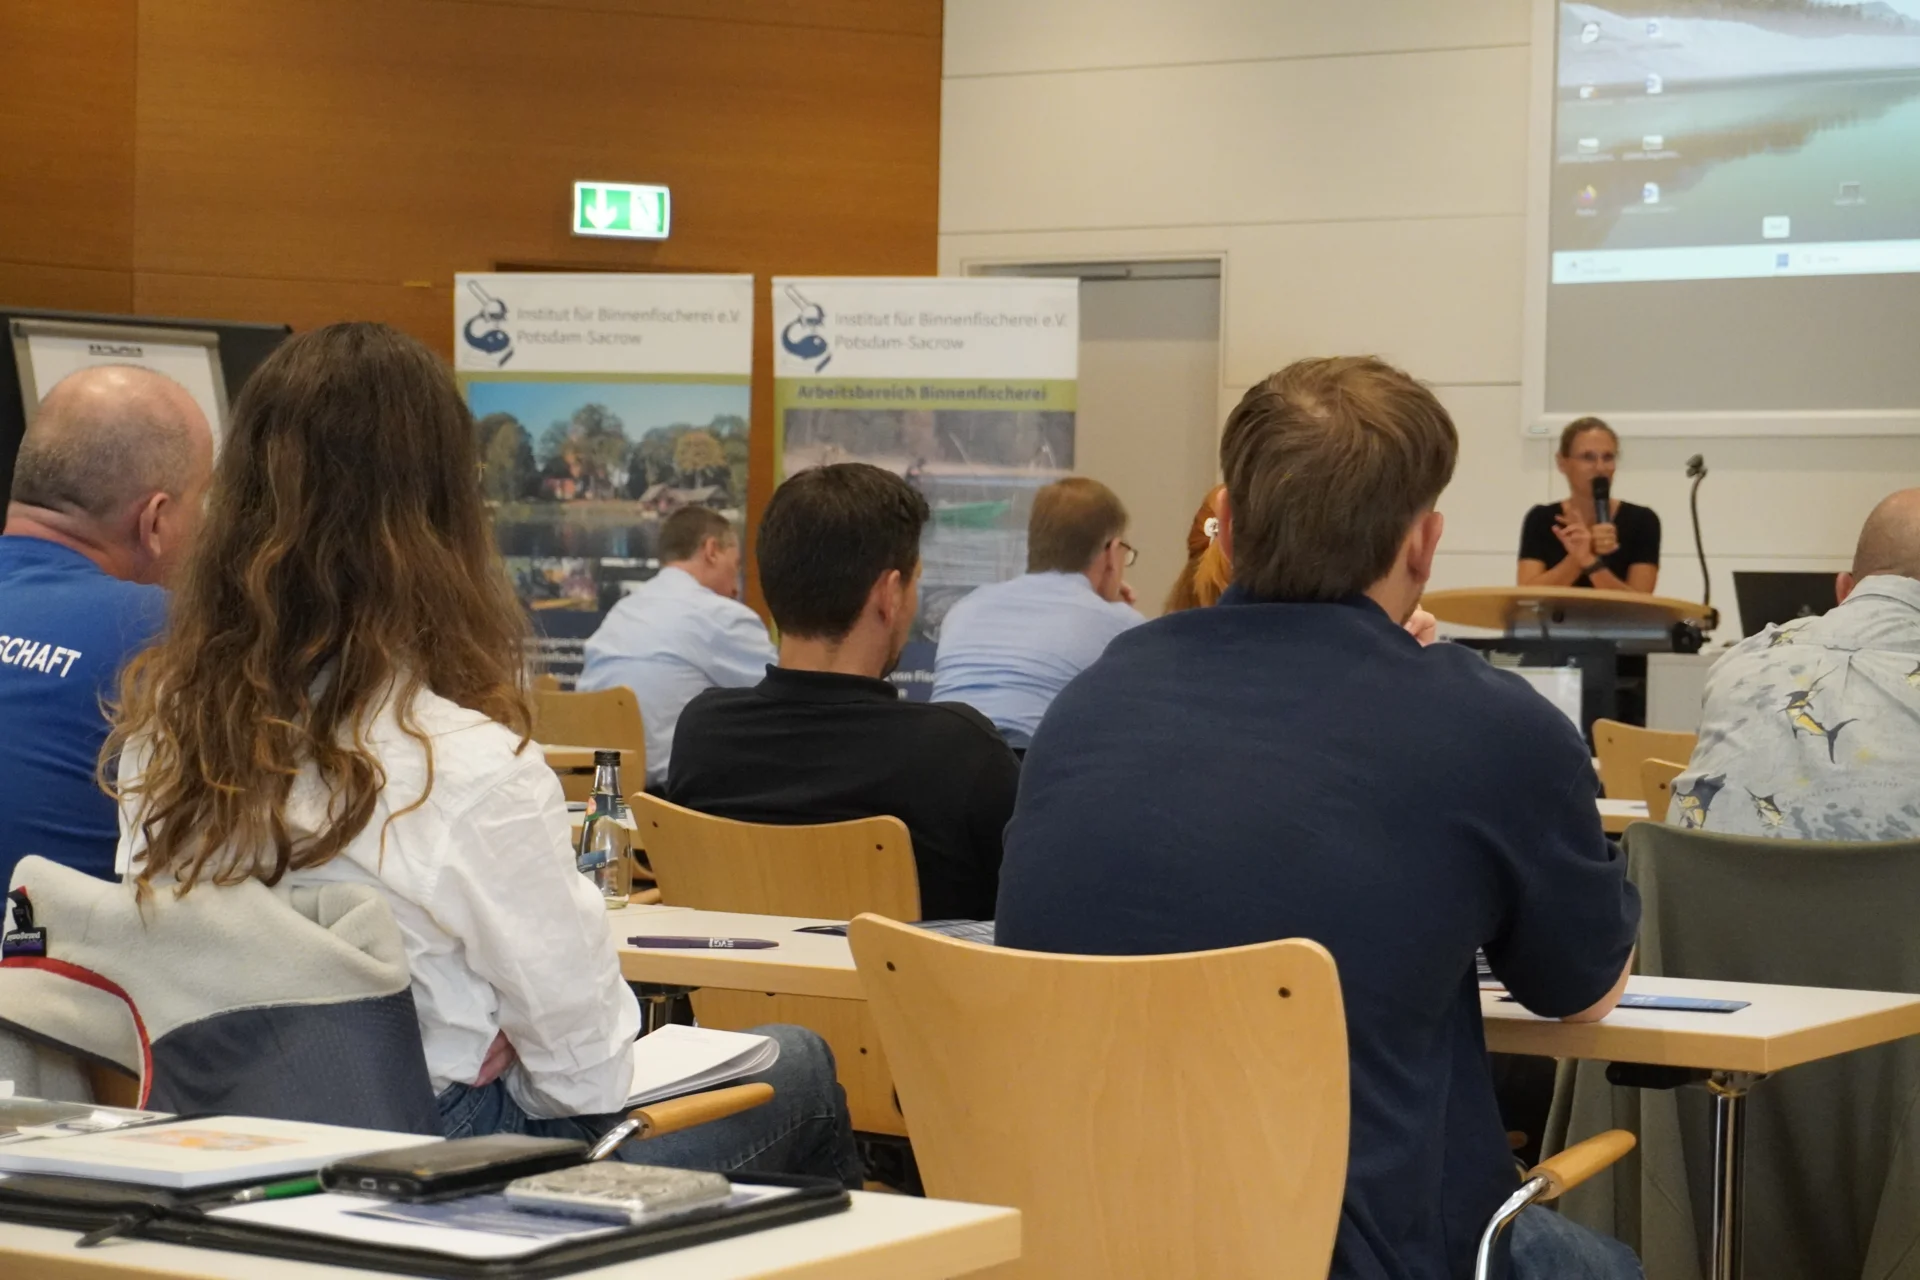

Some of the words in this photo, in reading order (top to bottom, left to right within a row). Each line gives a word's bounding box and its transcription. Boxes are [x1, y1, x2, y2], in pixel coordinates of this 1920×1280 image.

[516, 307, 569, 321] Institut
[573, 306, 594, 321] für
[598, 306, 714, 322] Binnenfischerei
[835, 311, 890, 326] Institut
[893, 311, 914, 326] für
[919, 311, 1038, 327] Binnenfischerei
[797, 385, 916, 400] Arbeitsbereich
[920, 385, 1047, 401] Binnenfischerei
